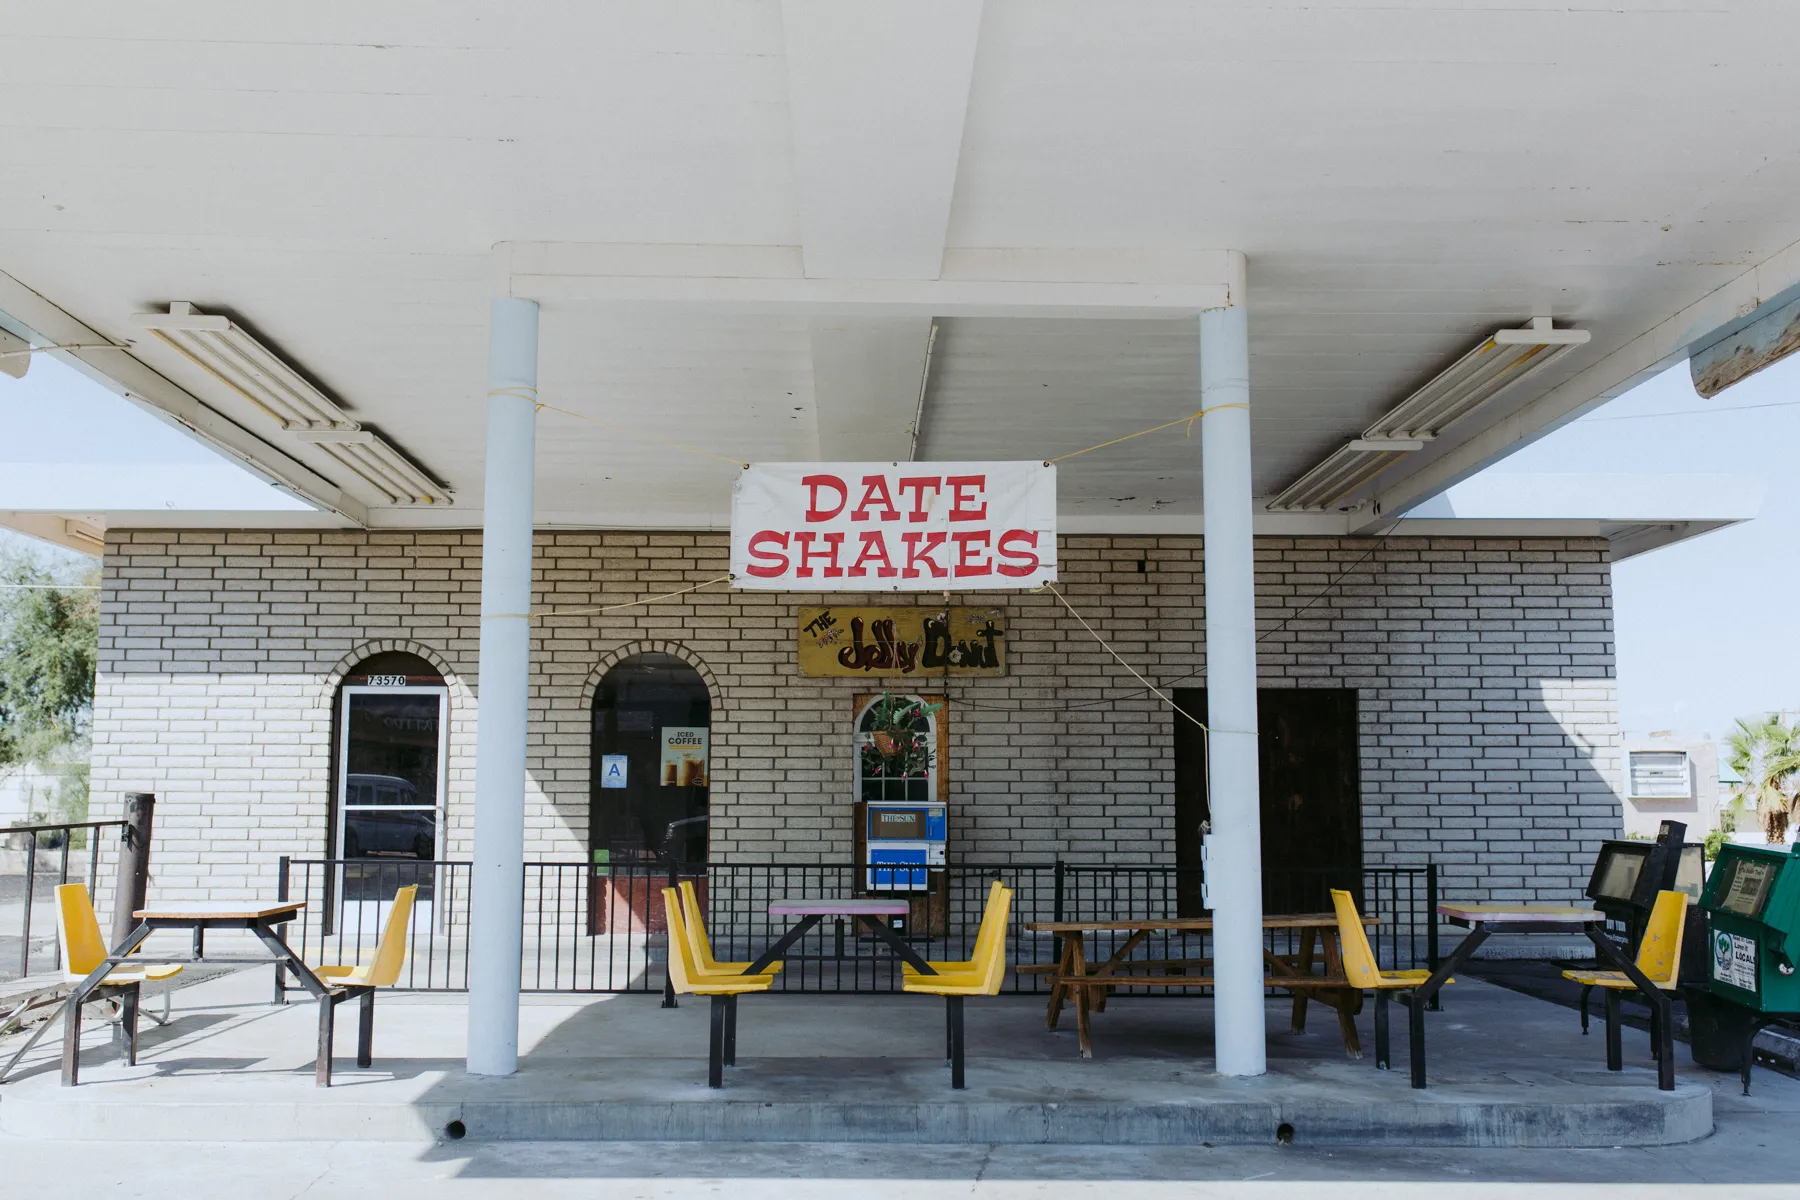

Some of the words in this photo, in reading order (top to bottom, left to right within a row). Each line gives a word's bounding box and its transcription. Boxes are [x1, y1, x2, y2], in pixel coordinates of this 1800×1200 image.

[801, 474, 987, 523] DATE
[745, 529, 1040, 579] SHAKES
[803, 611, 837, 638] THE
[837, 616, 919, 674] Jelly
[369, 675, 405, 686] 73570
[608, 763, 621, 777] A
